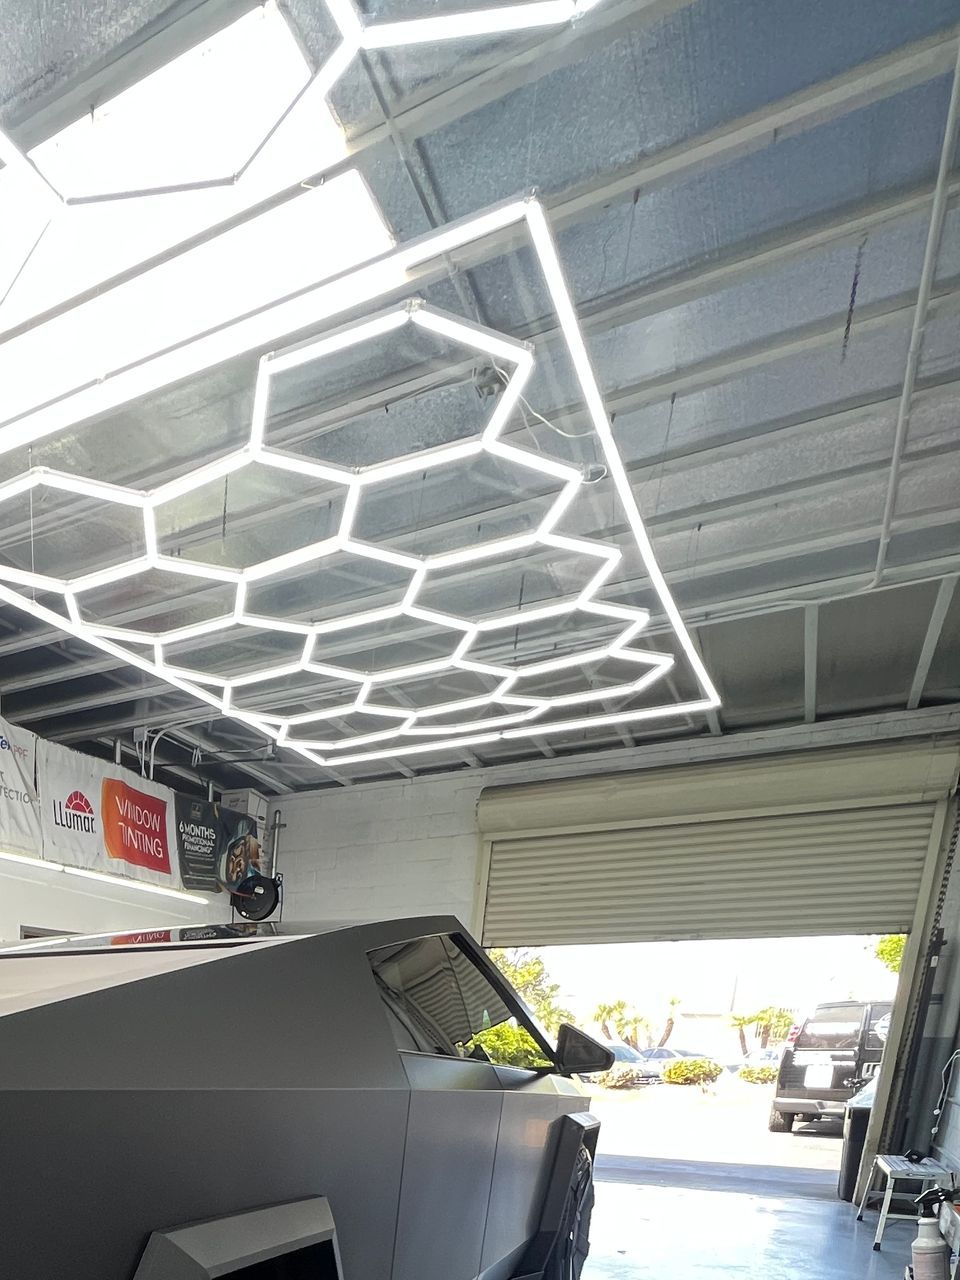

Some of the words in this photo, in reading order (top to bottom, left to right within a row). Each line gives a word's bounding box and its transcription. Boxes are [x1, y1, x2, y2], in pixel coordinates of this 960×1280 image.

[53, 799, 94, 833] LLumar
[115, 795, 160, 833] WINDOW
[179, 820, 184, 833] 6
[184, 822, 216, 840] MONTHS
[118, 822, 163, 858] TINTING
[182, 833, 215, 847] PROMOTIONAL
